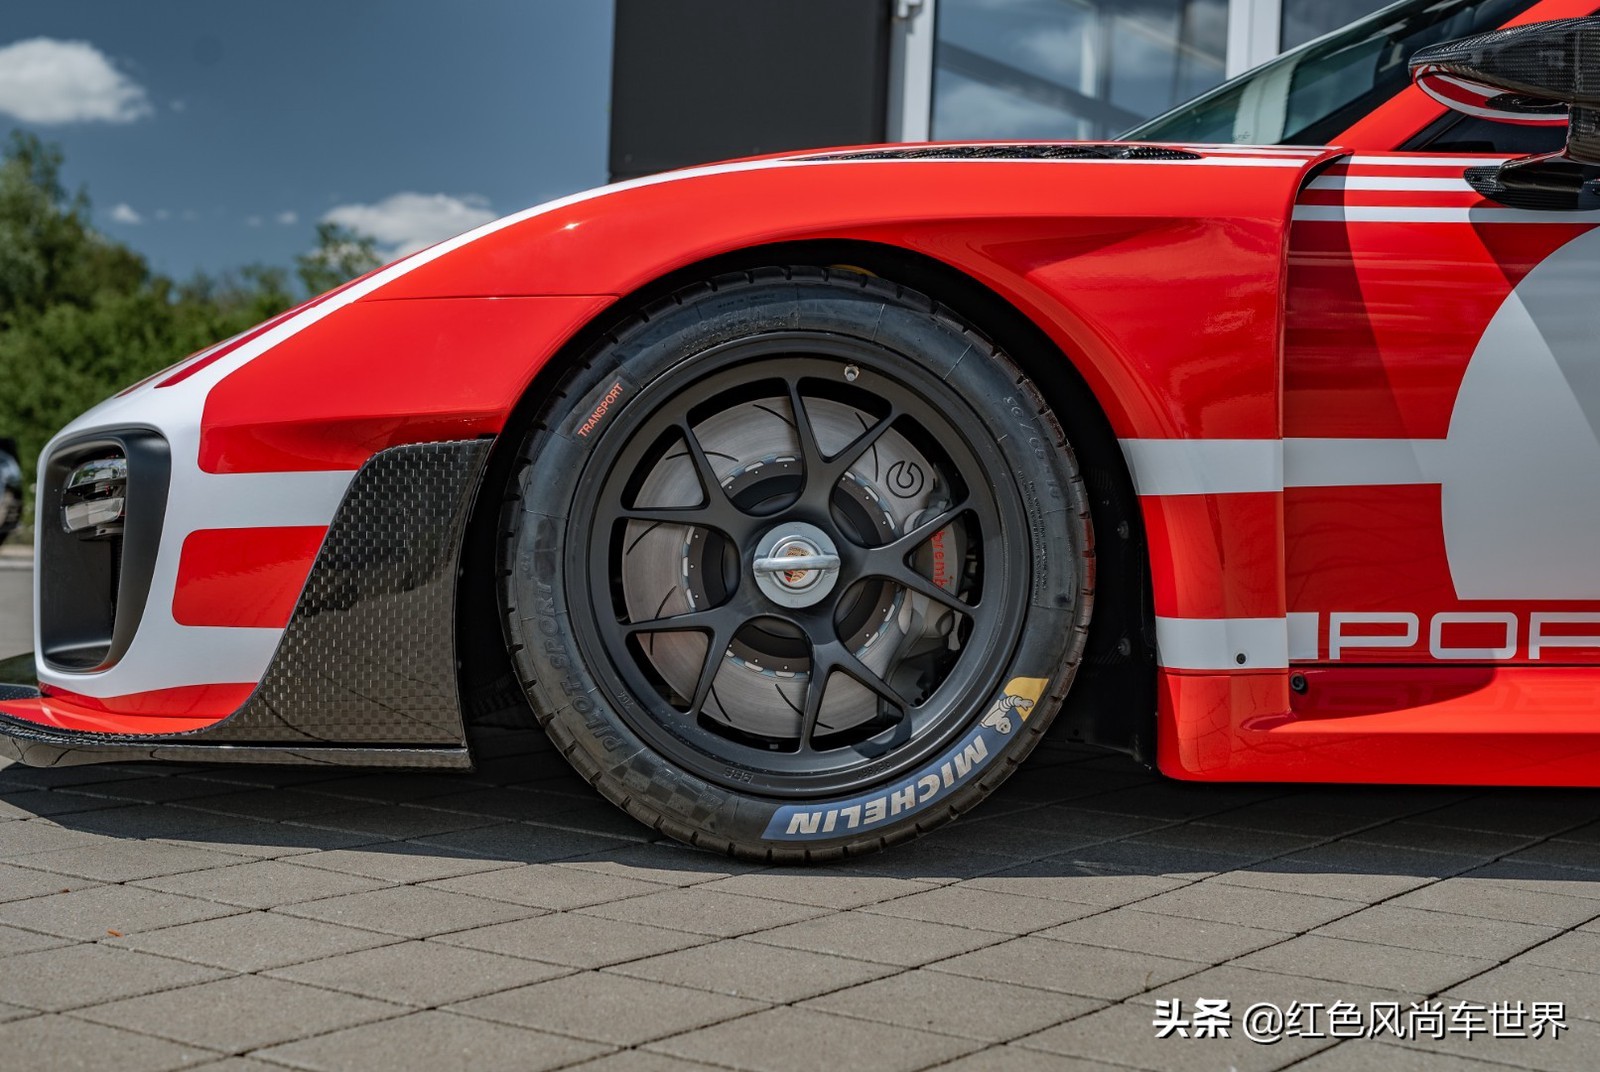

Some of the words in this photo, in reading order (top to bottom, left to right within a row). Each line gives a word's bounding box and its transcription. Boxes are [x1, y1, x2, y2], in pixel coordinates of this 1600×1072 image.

[576, 382, 624, 438] TRANSPORT
[532, 577, 570, 670] SPORT
[560, 678, 627, 753] PILOT
[785, 735, 989, 835] MICHELIN
